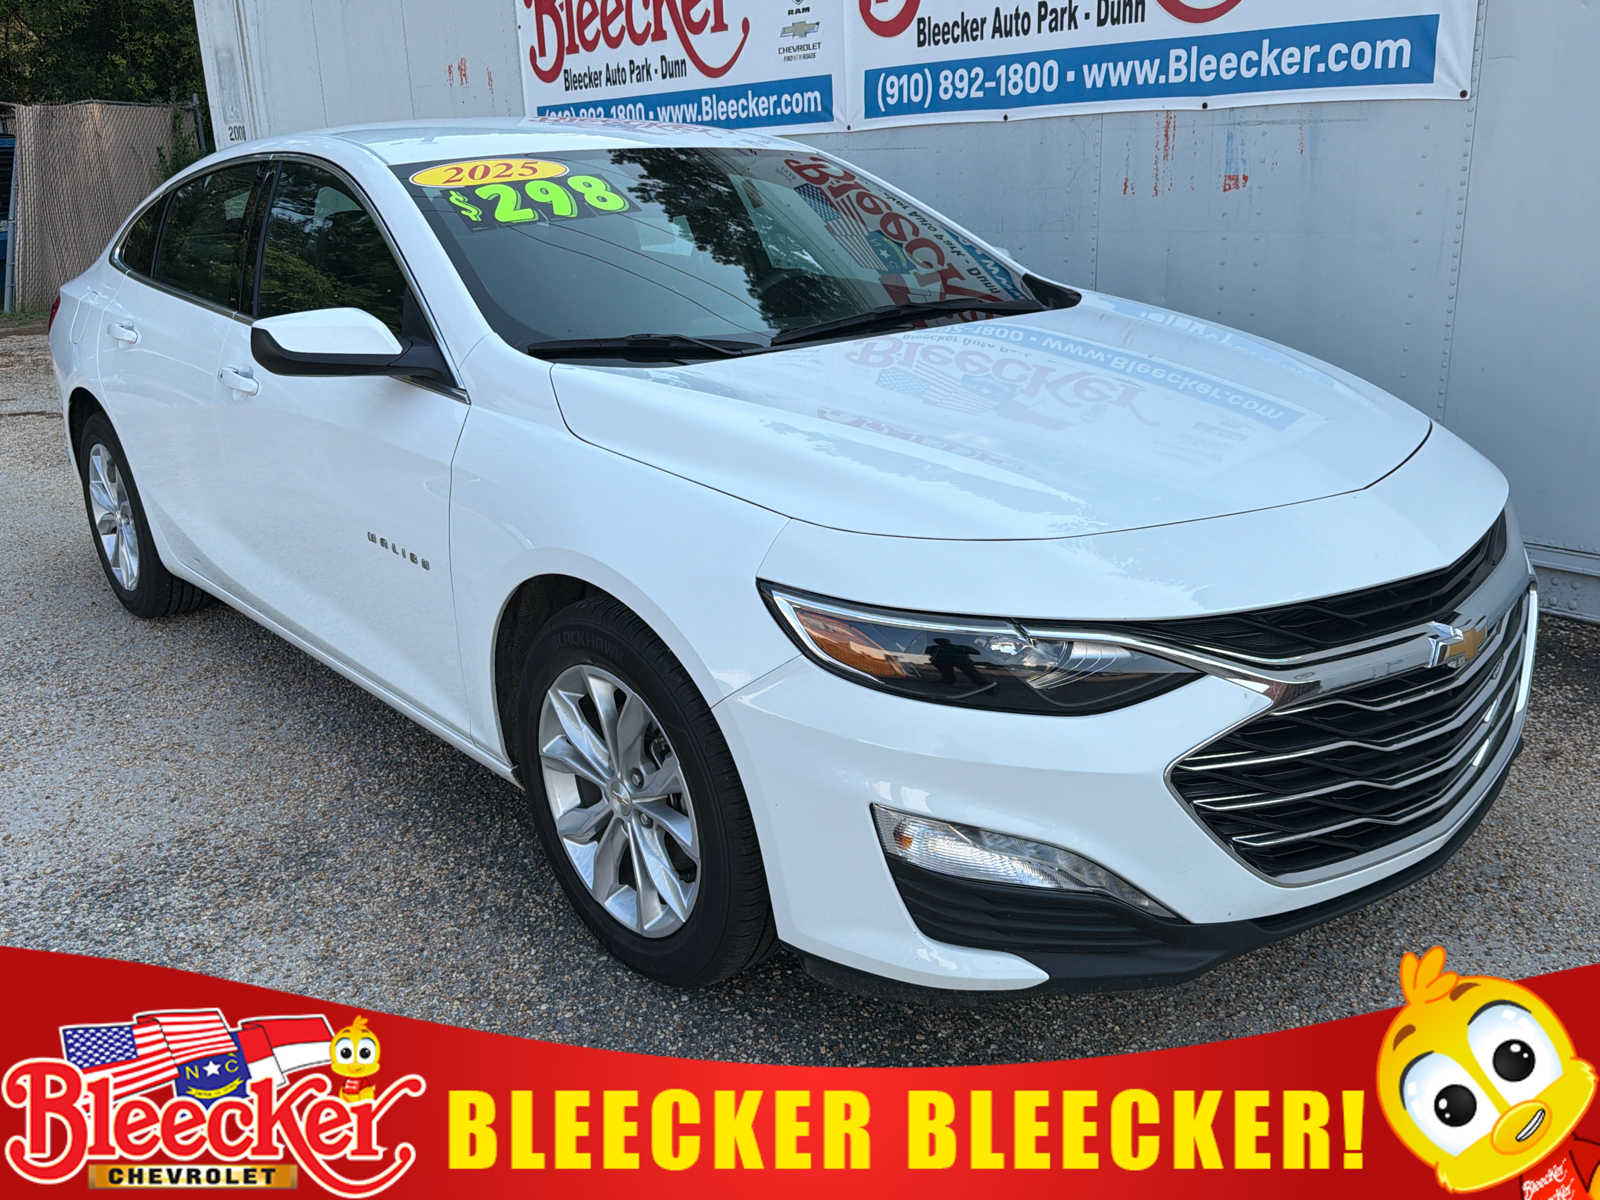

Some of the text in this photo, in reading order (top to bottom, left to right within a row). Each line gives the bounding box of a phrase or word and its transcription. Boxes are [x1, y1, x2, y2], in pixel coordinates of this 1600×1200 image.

[787, 6, 810, 16] RAM
[917, 12, 987, 48] Bleecker
[991, 6, 1031, 39] Auto
[1037, 0, 1079, 34] Park
[1096, 0, 1146, 27] Dunn
[523, 0, 750, 83] Bleecker
[778, 42, 822, 55] CHEVROLET
[563, 55, 687, 91] Bleecker Auto Park Dunn
[877, 38, 1412, 112] (910) 892-1800 www.Bleecker.com
[657, 90, 822, 122] www.Bleecker.com
[443, 161, 538, 184] 2025
[450, 174, 629, 223] $298
[367, 531, 430, 571] MALIBU
